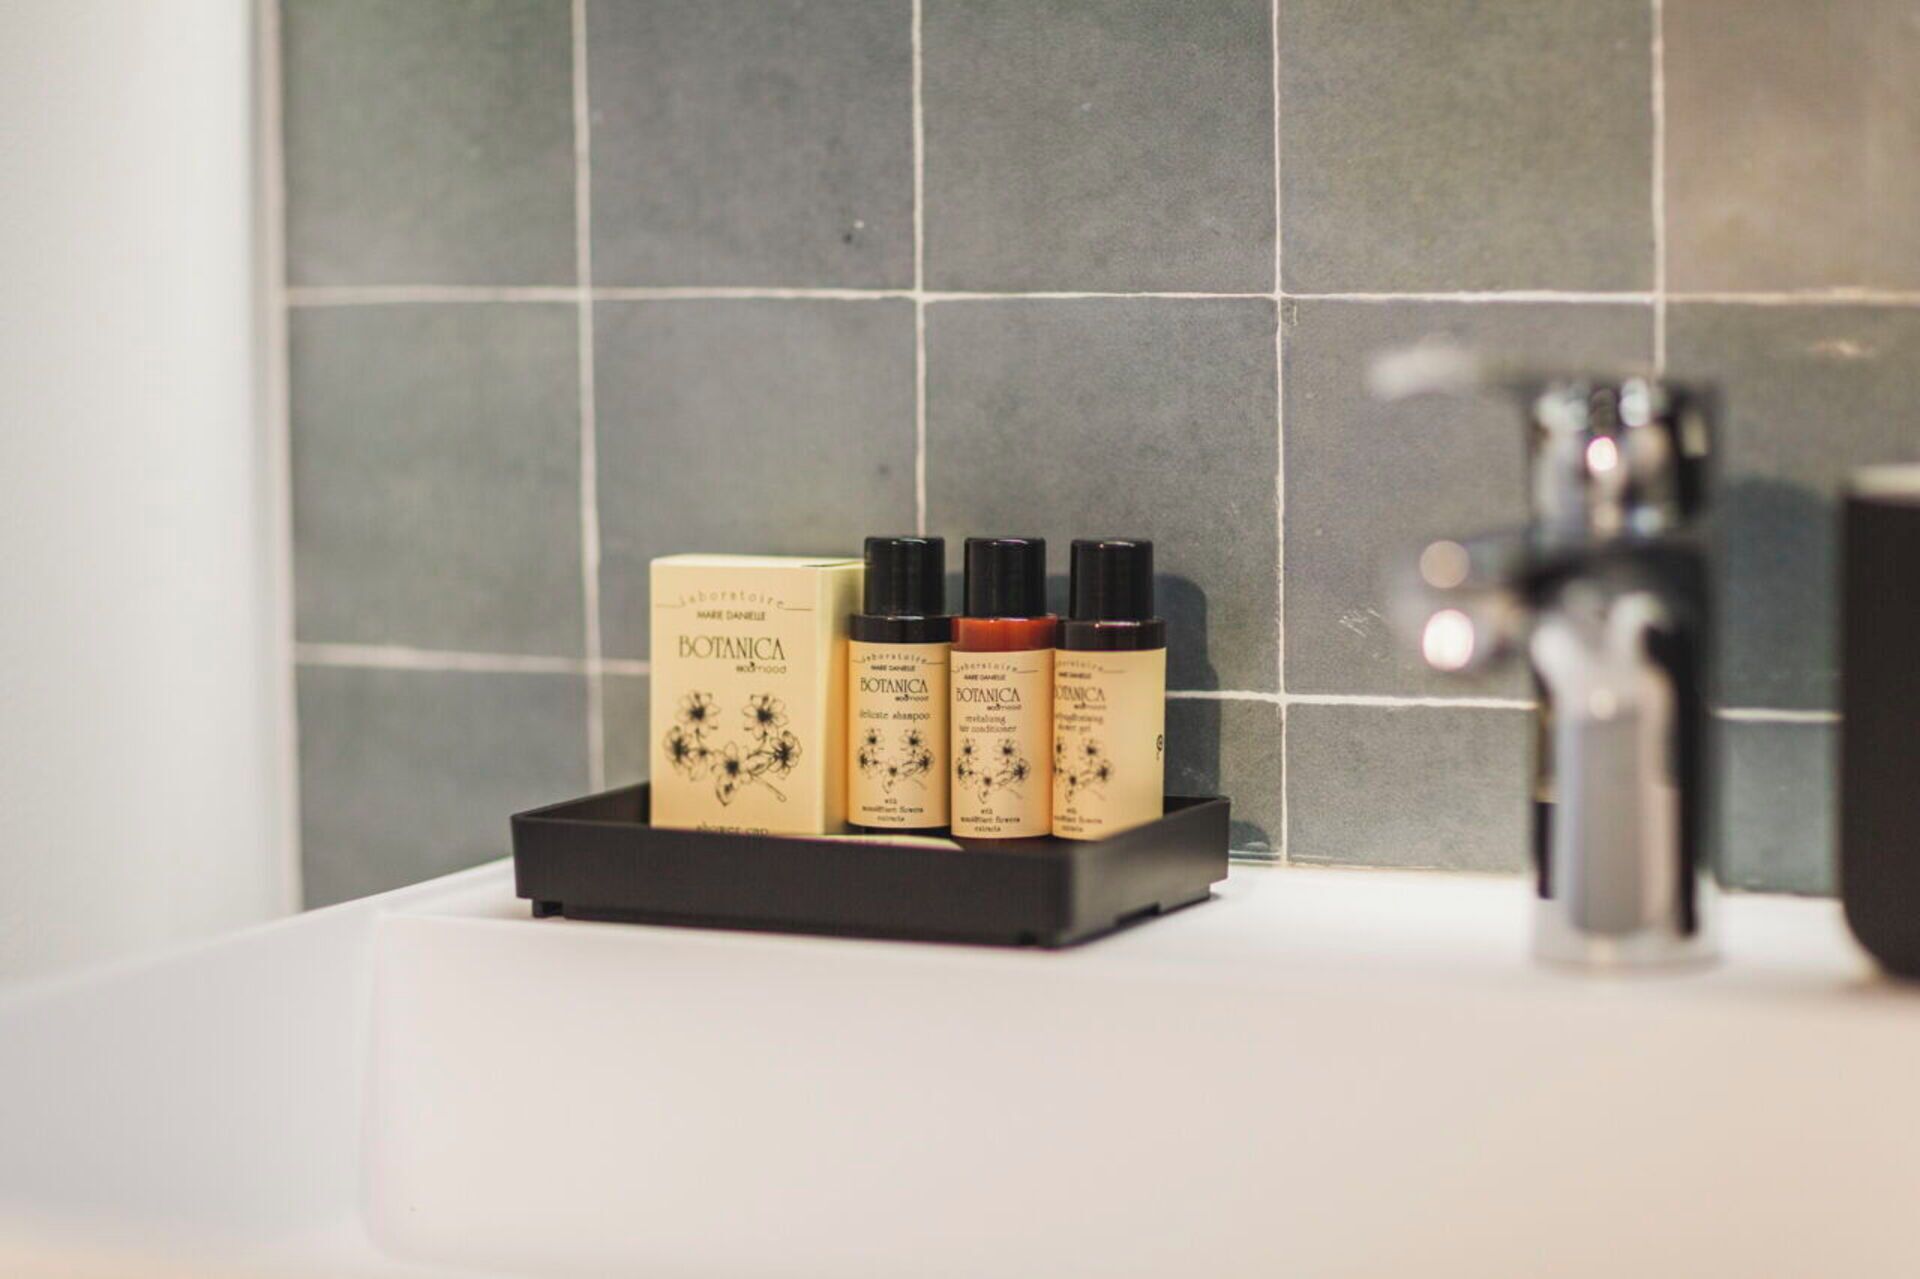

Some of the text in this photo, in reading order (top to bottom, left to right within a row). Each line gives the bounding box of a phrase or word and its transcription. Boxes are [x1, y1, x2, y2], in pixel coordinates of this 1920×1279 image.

[697, 610, 766, 622] MARIE DANIELLE
[678, 634, 786, 661] BOTANICA
[859, 676, 929, 694] BOTANICA
[1055, 685, 1106, 702] OTANICA
[956, 686, 1021, 703] BOTANICA
[892, 709, 931, 724] shampoo
